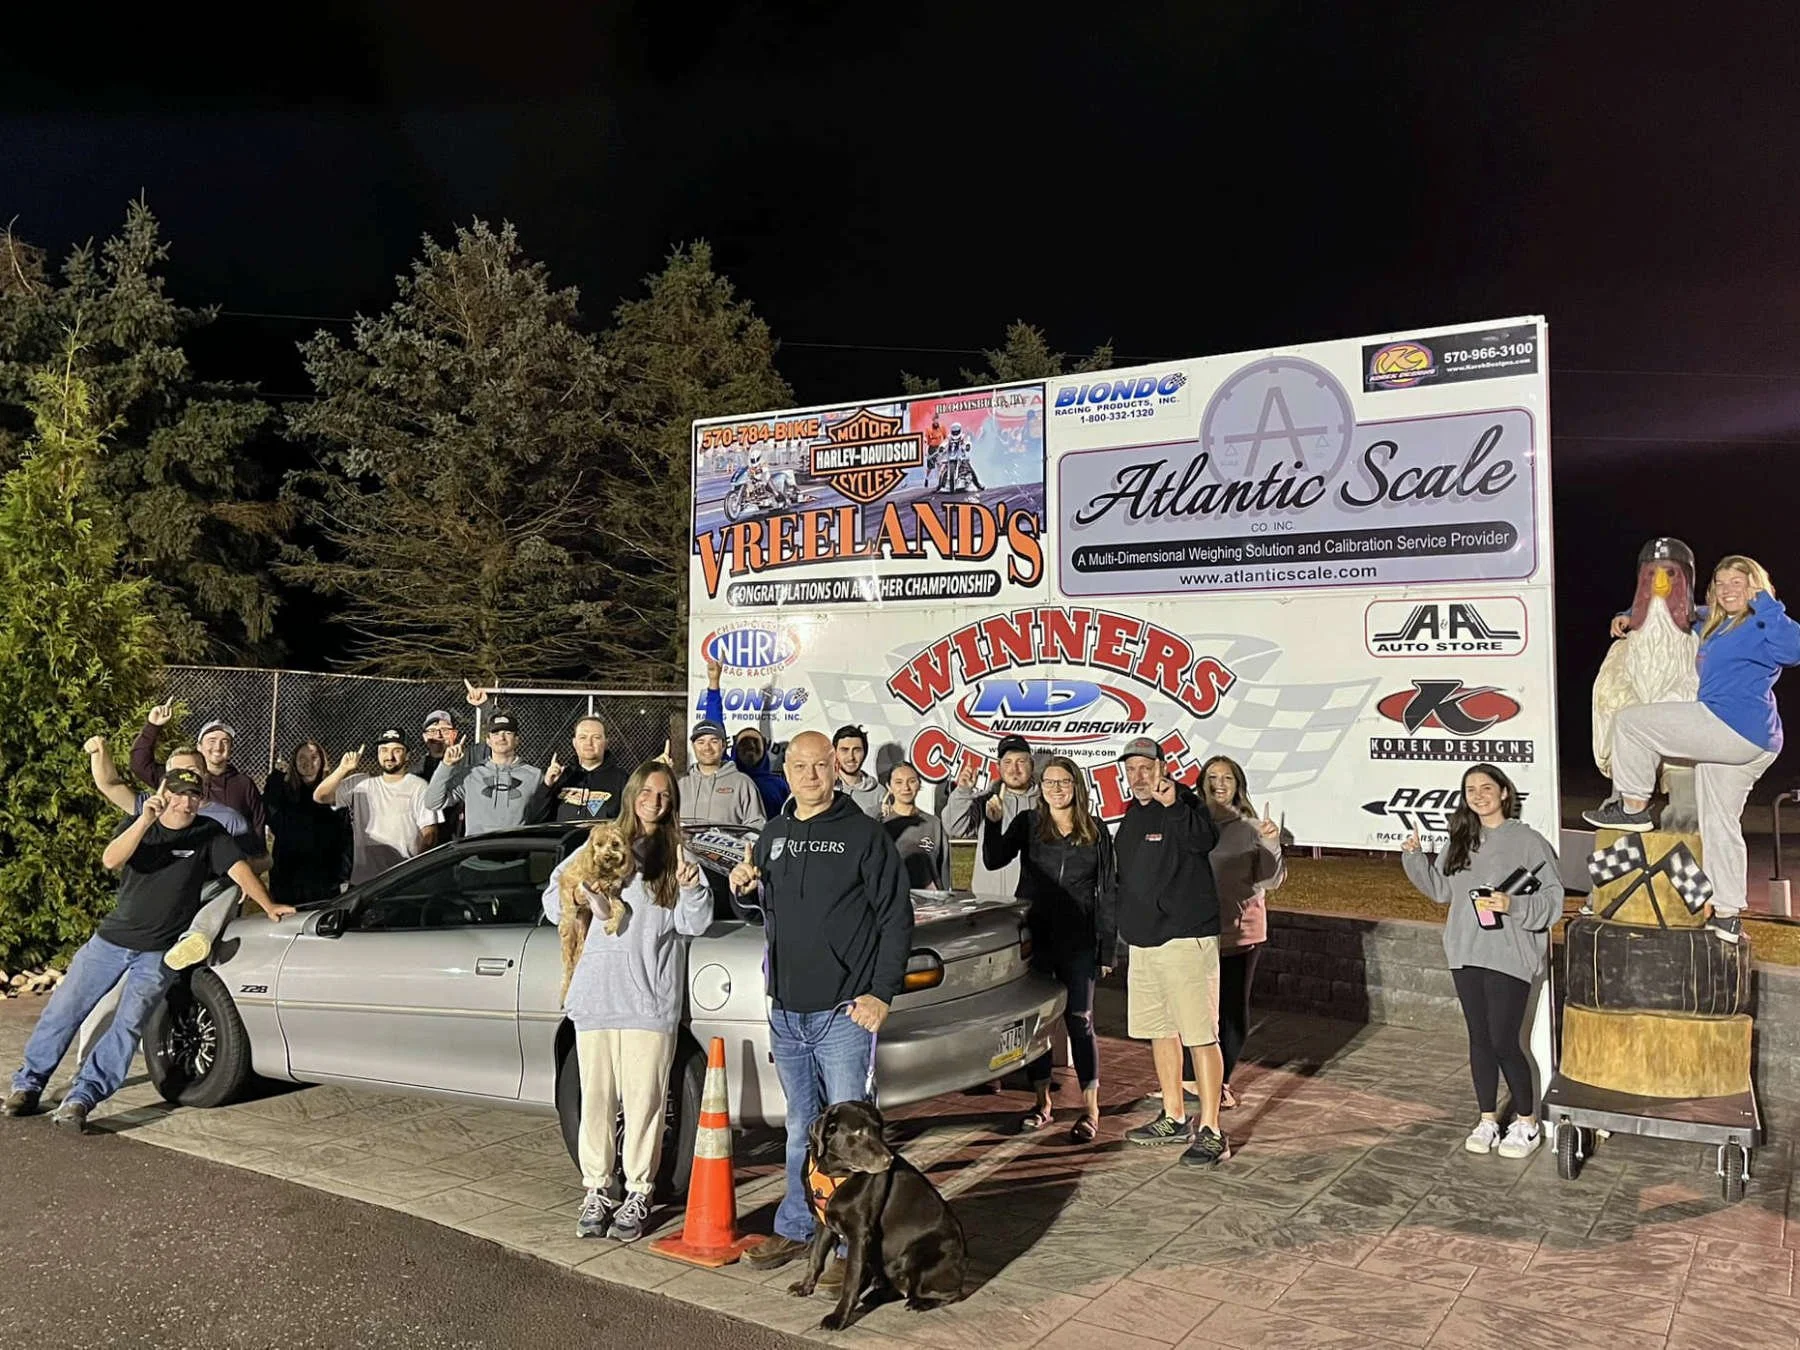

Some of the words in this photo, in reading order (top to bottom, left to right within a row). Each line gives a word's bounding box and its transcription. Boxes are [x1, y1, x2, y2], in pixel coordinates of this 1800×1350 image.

[1444, 342, 1533, 364] 570-966-3100
[1055, 372, 1185, 407] BIONDO
[1055, 406, 1091, 416] RACING
[1097, 399, 1153, 411] PRODUCTS,
[1159, 396, 1180, 405] INC.
[1080, 408, 1154, 423] 1-800-332-1320
[702, 418, 819, 448] 570-784-BIKE
[838, 417, 892, 441] MOTOR
[816, 441, 917, 469] HARLEY-DAVIDSON
[839, 469, 895, 497] CYCLES
[1075, 452, 1327, 524] Atlantic
[1340, 424, 1518, 507] Scale
[695, 502, 1045, 599] VREELAND'S
[1077, 555, 1087, 567] A
[1089, 548, 1185, 566] Multi-Dimensional
[1188, 546, 1242, 563] Weighing
[1246, 542, 1294, 558] Solution
[1298, 541, 1321, 556] and
[1324, 536, 1393, 554] Calibration
[1397, 534, 1447, 550] Service
[1451, 530, 1511, 547] Provider
[1179, 565, 1377, 585] www.atlanticscale.com
[732, 581, 831, 603] CONGRATULATIONS
[833, 581, 850, 599] ON
[850, 578, 904, 599] AHER
[905, 573, 996, 597] CHAMPIONSHIP
[717, 630, 789, 667] NHRA
[1377, 643, 1429, 652] AUTO
[1436, 642, 1503, 650] STORE
[721, 665, 743, 678] RAG
[746, 664, 785, 678] RACING
[887, 606, 1236, 716] WINNERS
[696, 687, 808, 712] BONDO
[695, 713, 727, 721] RAG
[731, 713, 780, 722] PRODUCTS,
[785, 713, 803, 721] INC.
[990, 719, 1061, 733] NUMIDIA
[1064, 720, 1152, 735] DRAGWAY
[988, 744, 1117, 758] widiadragway.com
[1371, 739, 1432, 751] KOREK
[1445, 740, 1533, 754] DESIGNS
[909, 724, 1204, 822] CILE
[1376, 832, 1402, 841] RACE
[1406, 834, 1433, 842] CRS
[240, 984, 268, 994] Z28
